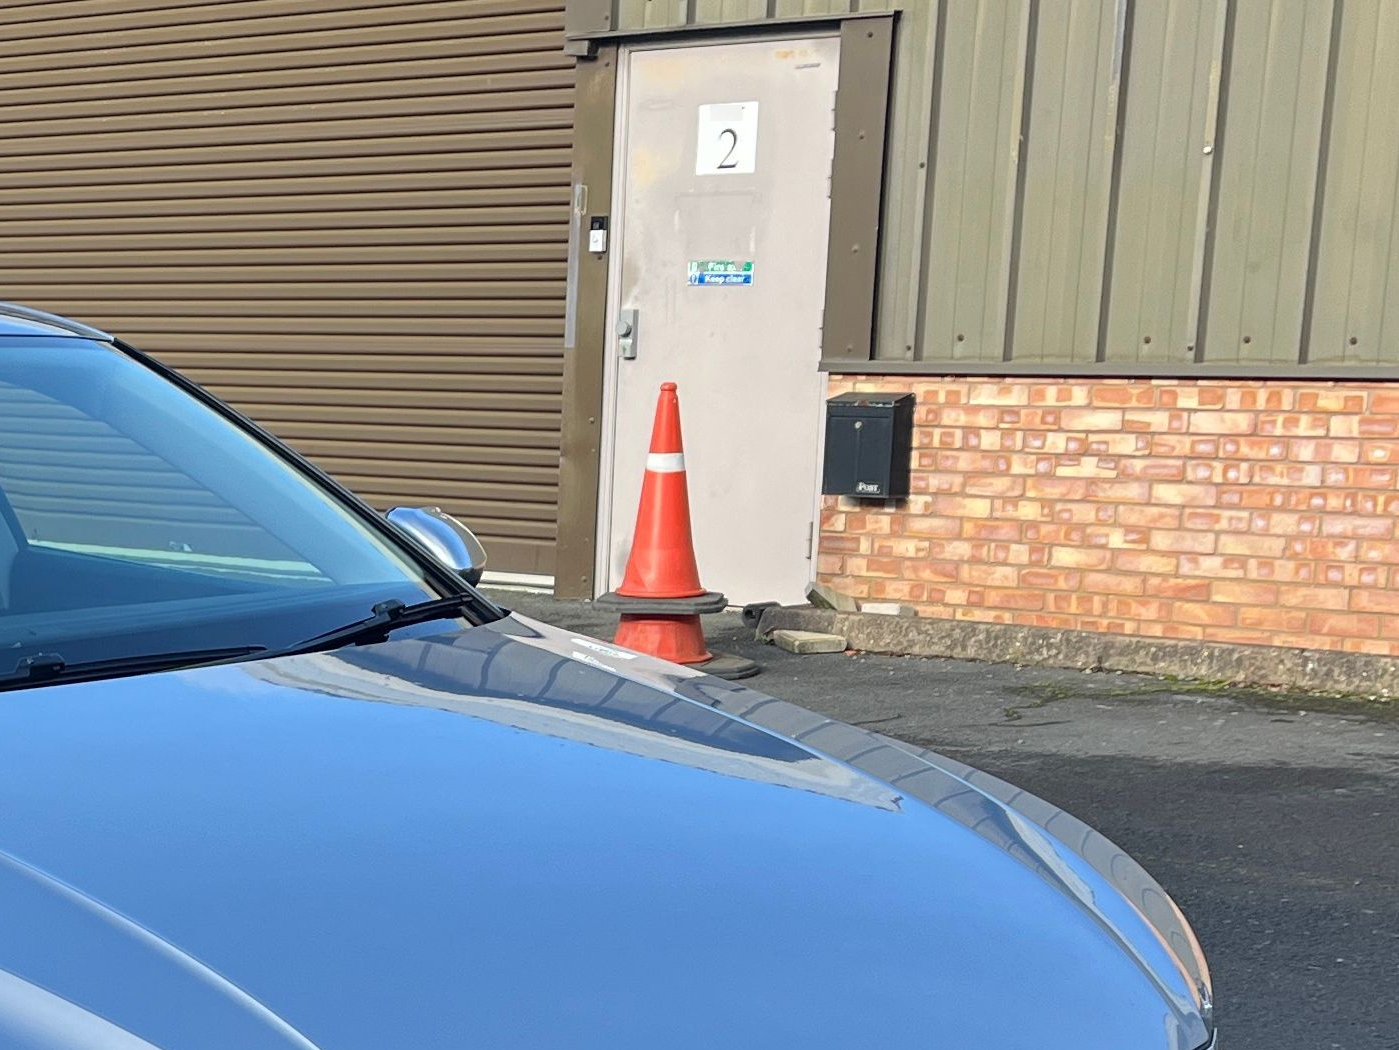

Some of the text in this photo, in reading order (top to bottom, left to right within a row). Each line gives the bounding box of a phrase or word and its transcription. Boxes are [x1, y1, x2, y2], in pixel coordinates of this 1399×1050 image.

[717, 128, 738, 169] 2
[705, 274, 745, 284] Keep clear
